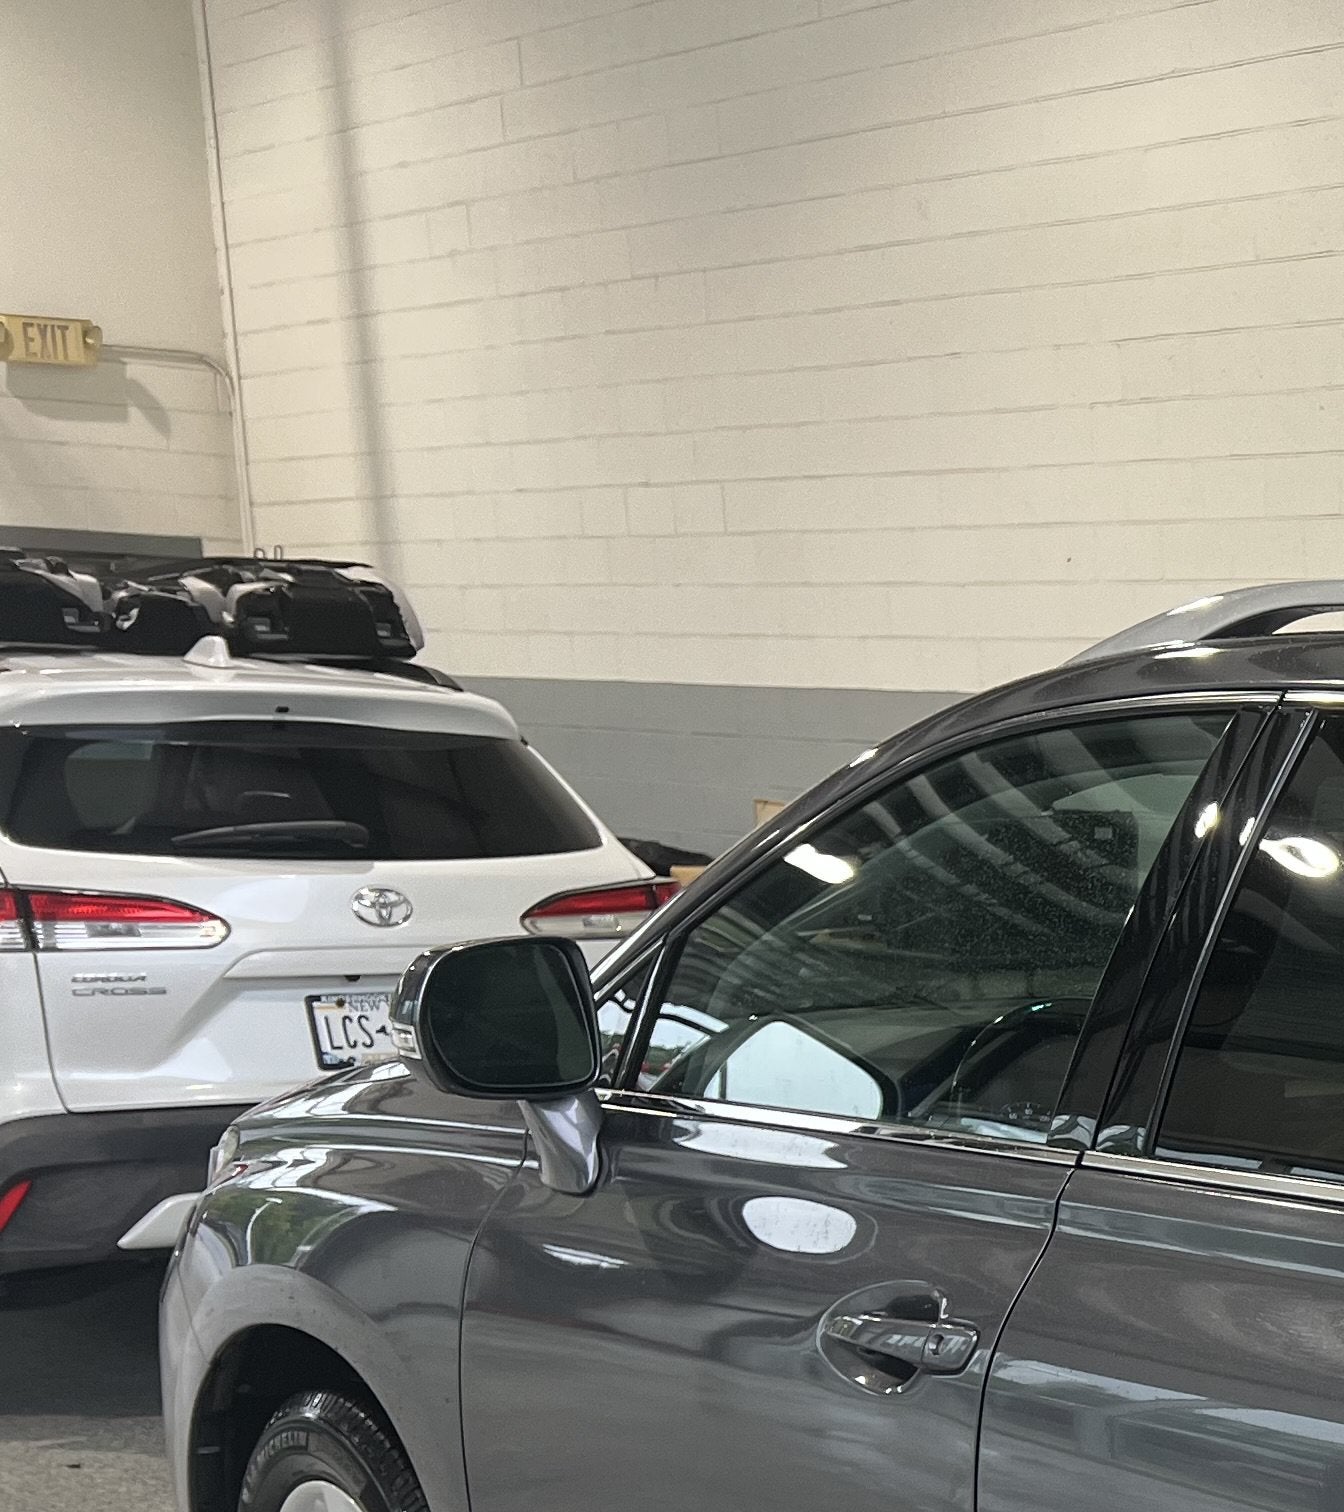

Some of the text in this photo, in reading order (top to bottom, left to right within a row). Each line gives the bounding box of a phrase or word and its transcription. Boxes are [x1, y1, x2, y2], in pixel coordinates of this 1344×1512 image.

[22, 322, 69, 360] EXIT
[72, 986, 167, 997] CROSS
[323, 1014, 375, 1050] LCS
